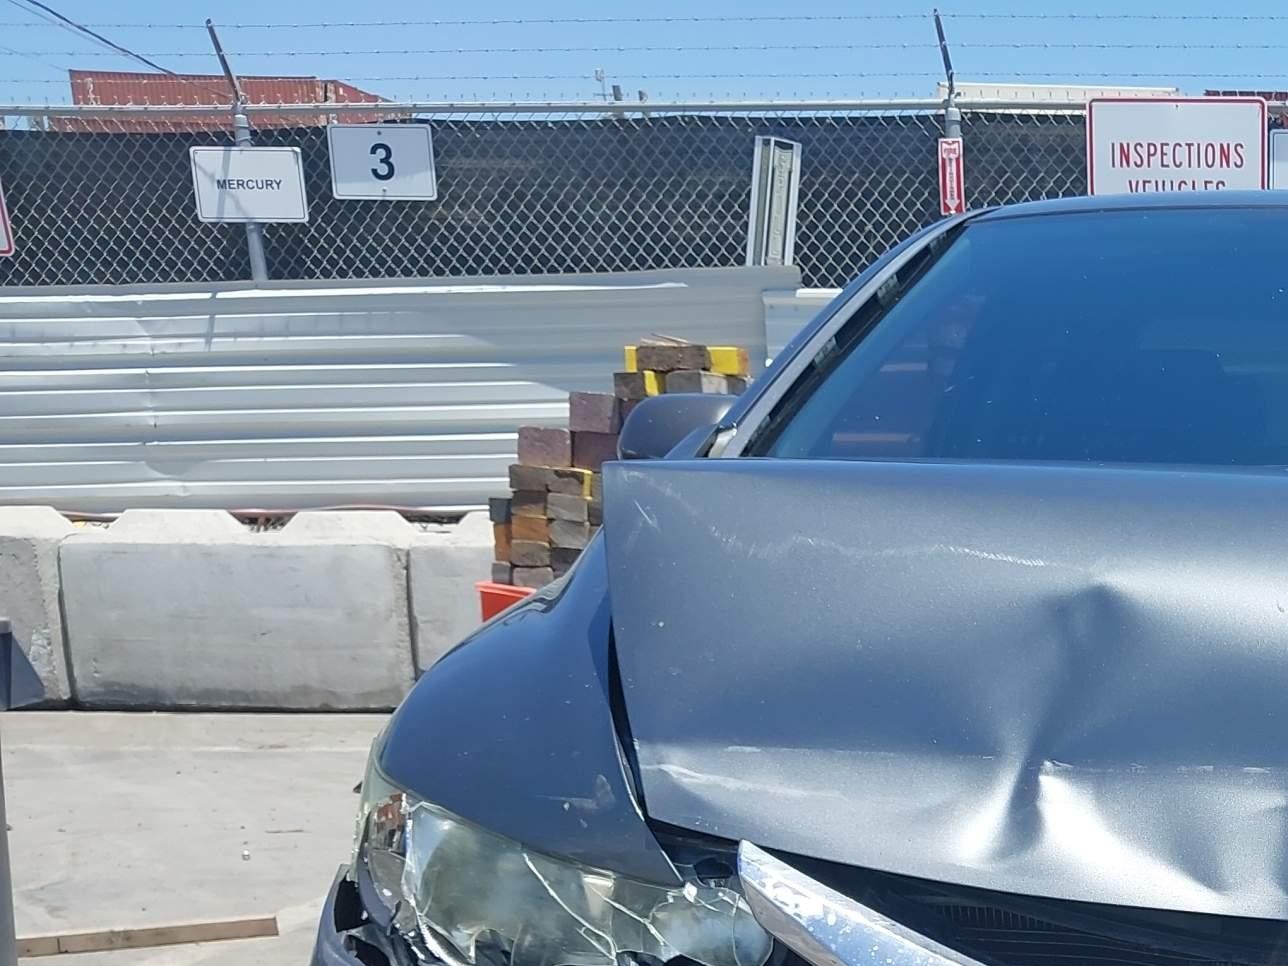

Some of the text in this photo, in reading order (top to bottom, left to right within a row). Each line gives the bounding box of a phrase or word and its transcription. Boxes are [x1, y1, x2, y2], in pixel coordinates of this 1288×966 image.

[370, 143, 395, 181] 3
[1111, 142, 1245, 169] INSPECTIONS
[216, 178, 283, 190] MERCURY
